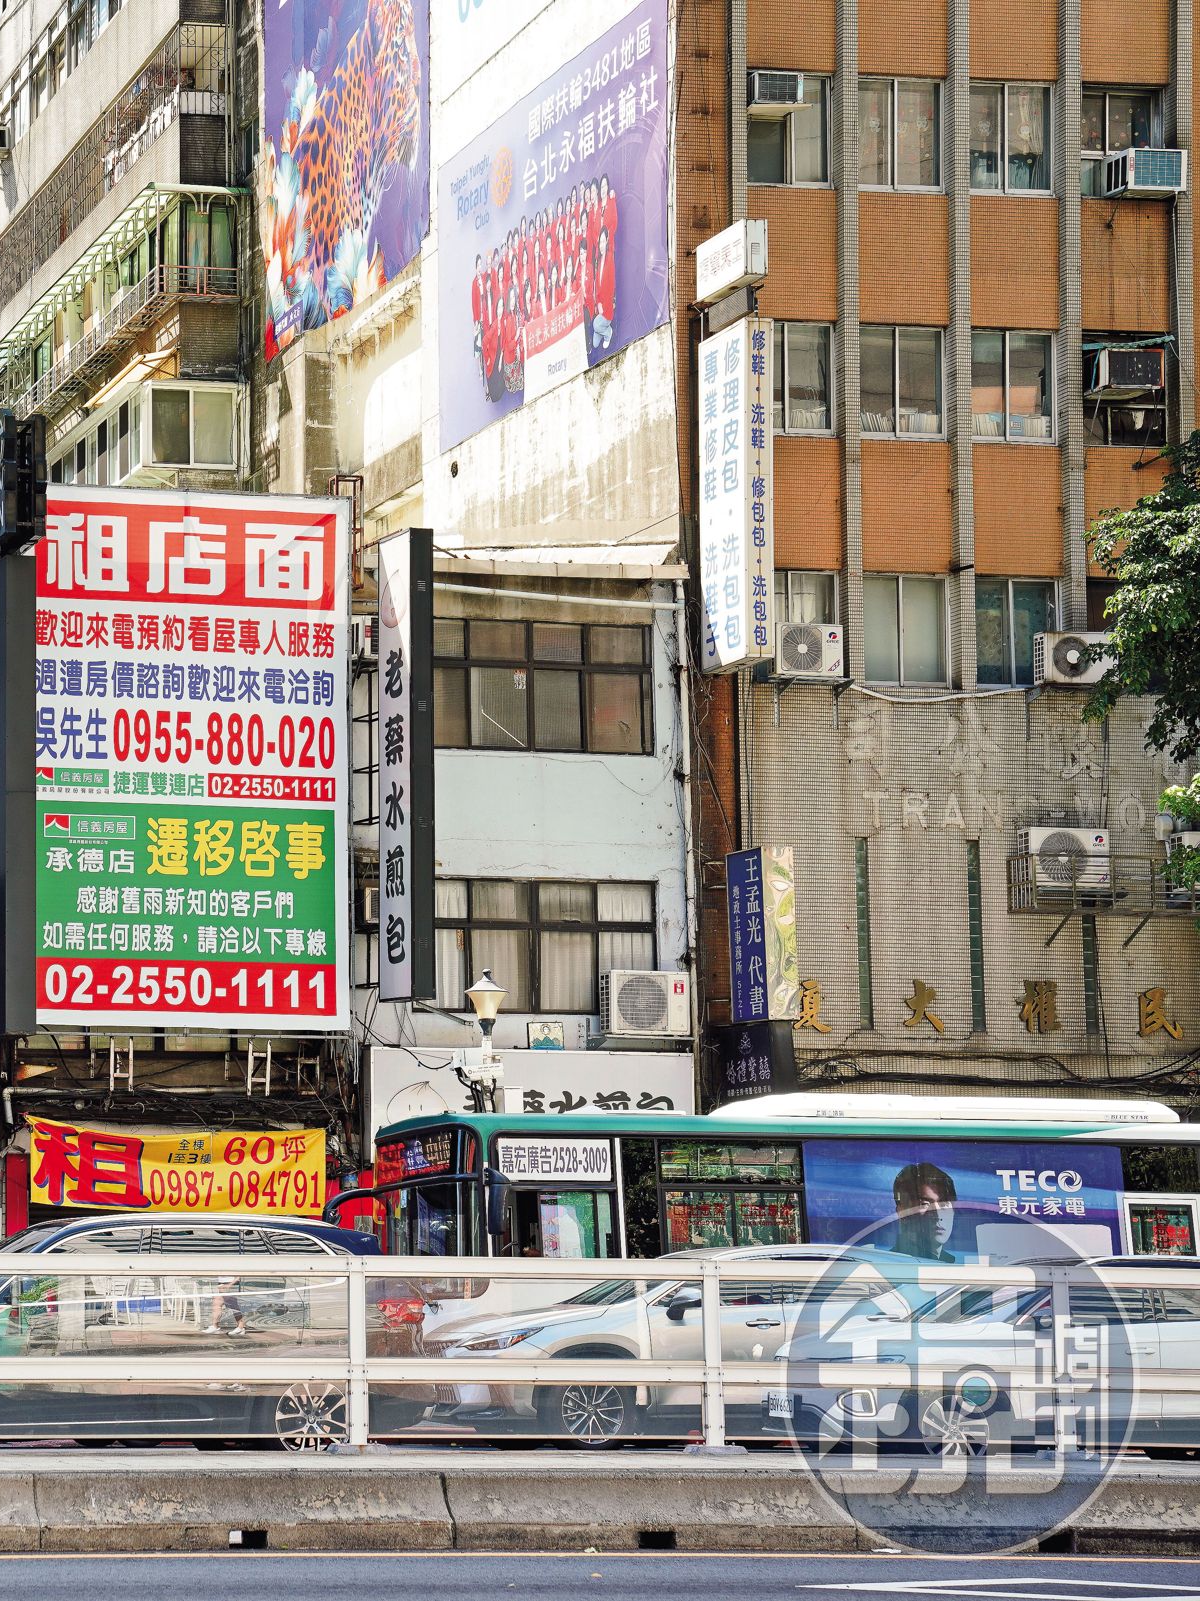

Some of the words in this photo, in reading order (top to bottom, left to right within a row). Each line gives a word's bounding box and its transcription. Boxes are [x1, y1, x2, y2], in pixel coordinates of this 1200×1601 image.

[528, 18, 652, 144] 國際扶輪3481地區
[522, 65, 659, 201] 台北永福扶輪社
[457, 180, 489, 221] Rotary
[475, 210, 490, 230] Club
[47, 510, 325, 602] 租店面
[36, 608, 335, 659] 歡迎來電預約看屋專人服務
[36, 658, 334, 706] 週遭房價諮詢歡迎來電洽詢
[112, 707, 335, 770] 0955-880-020
[60, 771, 104, 783] 信義房屋
[113, 771, 205, 797] 捷運雙連店
[211, 775, 334, 800] 02-2550-1111
[77, 820, 128, 834] 信義房屋
[384, 648, 406, 966] 老蔡水煎包
[45, 846, 135, 875] 承德店
[744, 854, 762, 946] 王孟光
[44, 964, 327, 1009] 02-2550-1111
[748, 955, 764, 1016] 代書
[33, 1121, 152, 1208] 租
[178, 1139, 205, 1151] 全棟
[501, 1144, 608, 1175] 嘉宏廣告2528-3009
[996, 1169, 1083, 1193] TECO
[997, 1196, 1086, 1216] 東元家電
